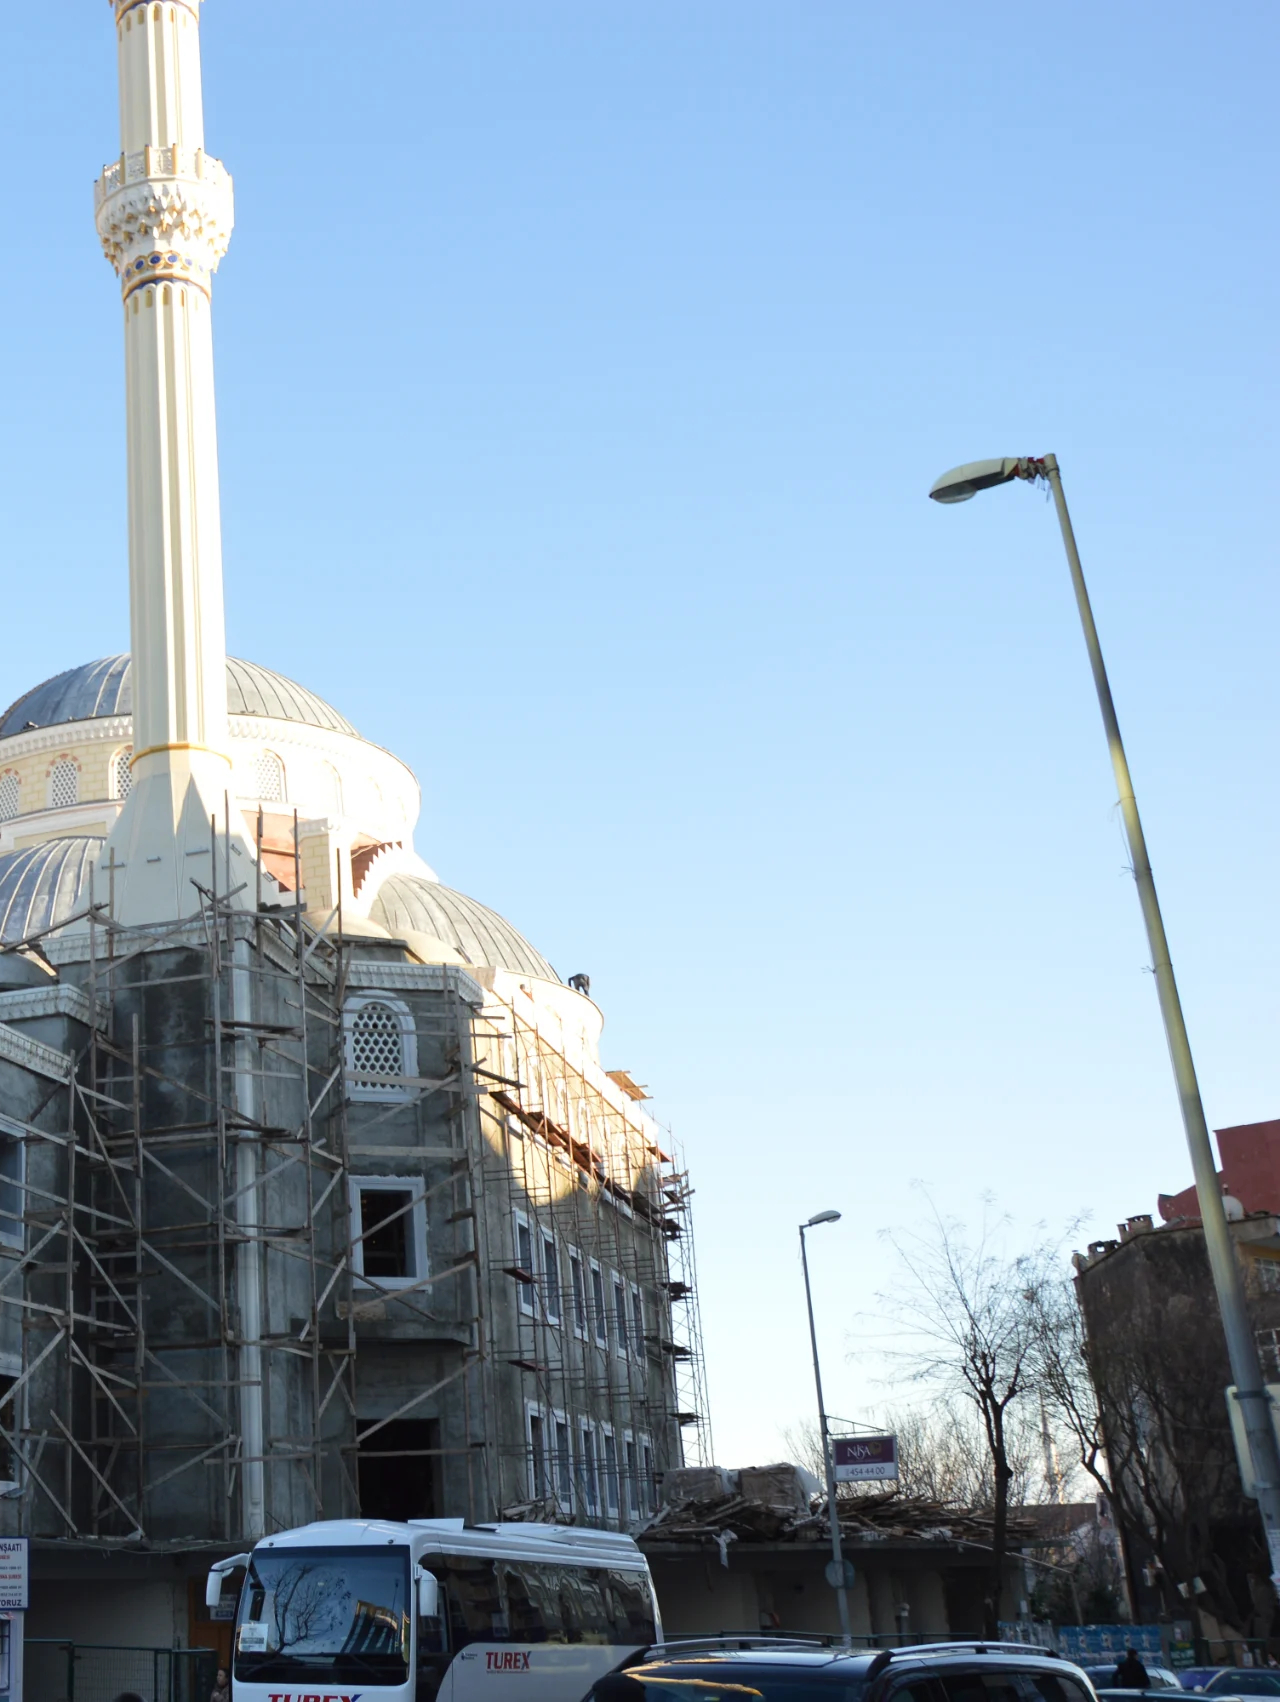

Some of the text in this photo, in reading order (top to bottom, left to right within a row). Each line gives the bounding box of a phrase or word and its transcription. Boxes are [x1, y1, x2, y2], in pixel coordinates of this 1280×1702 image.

[850, 1467, 863, 1476] 454
[864, 1467, 874, 1475] 44
[875, 1466, 885, 1475] 00
[486, 1650, 532, 1670] TUREX
